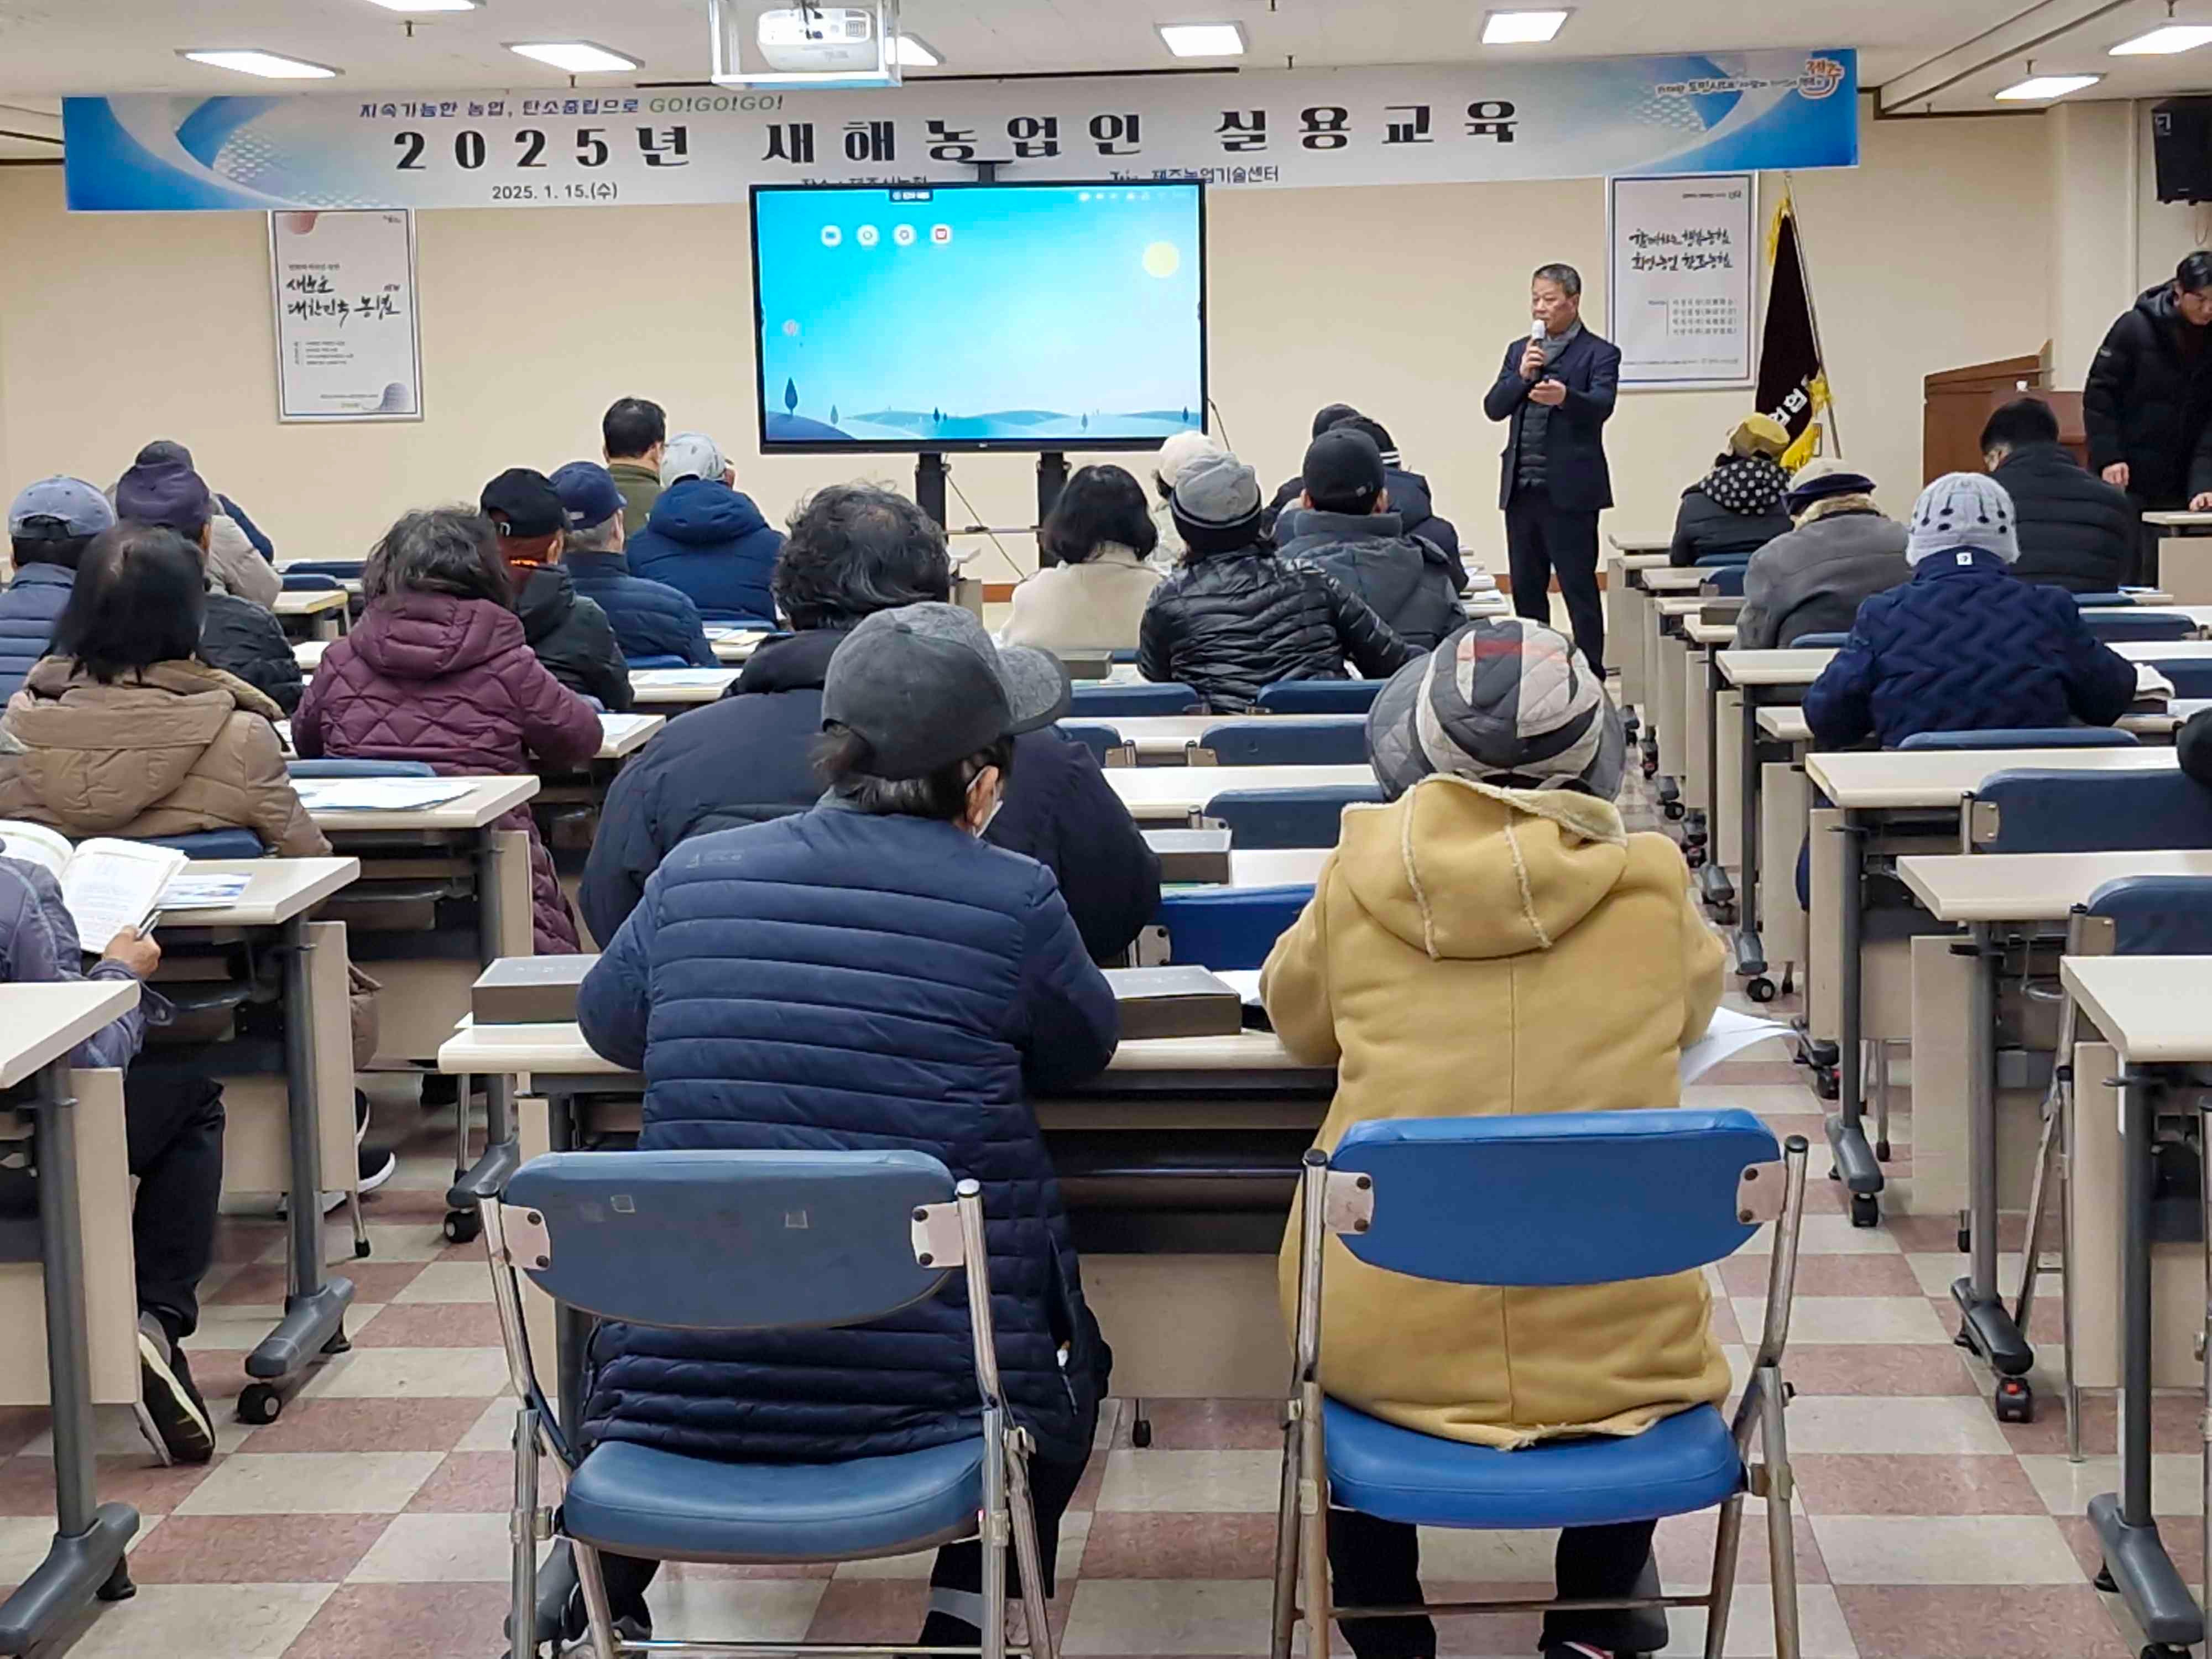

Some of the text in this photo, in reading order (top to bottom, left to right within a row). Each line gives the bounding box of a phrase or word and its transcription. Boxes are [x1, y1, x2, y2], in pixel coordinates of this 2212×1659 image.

[359, 101, 458, 118] 지속가능한
[468, 101, 513, 118] 농업,
[522, 98, 639, 116] 탄소중립으로
[394, 125, 690, 170] 2025년
[1214, 101, 1519, 152] 실용교육
[492, 185, 538, 200] 2025.
[565, 181, 618, 200] 15.(수)
